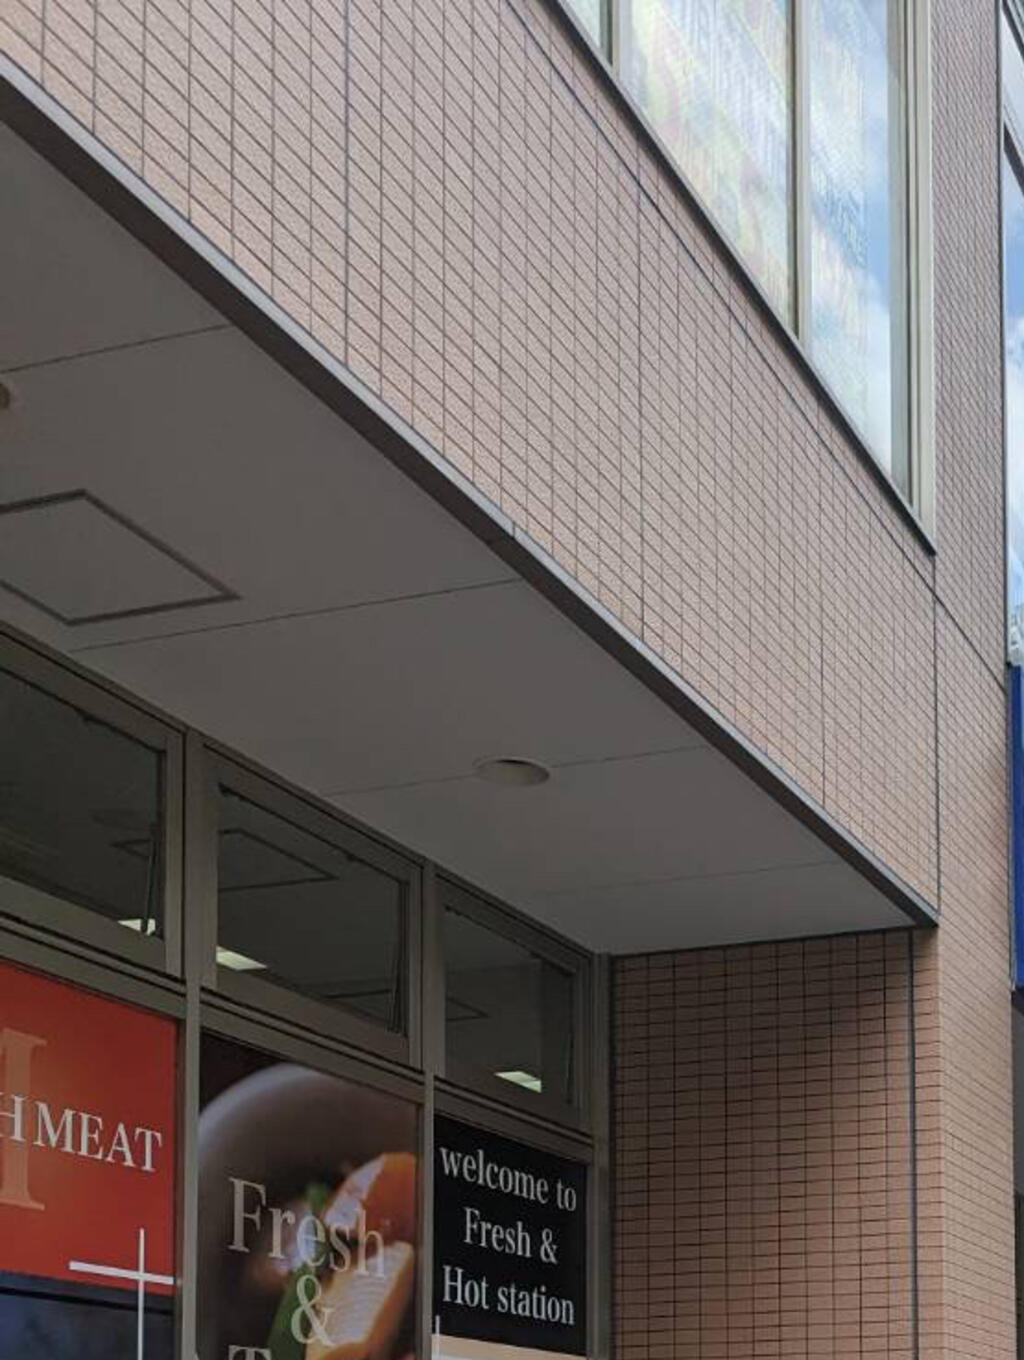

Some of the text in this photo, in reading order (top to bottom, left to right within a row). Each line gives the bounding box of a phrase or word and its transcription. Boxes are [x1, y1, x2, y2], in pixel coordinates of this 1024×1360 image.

[33, 1101, 163, 1173] MEAT
[440, 1147, 577, 1211] welcome to
[228, 1177, 387, 1280] Fresh
[464, 1206, 558, 1265] Fresh &
[291, 1274, 335, 1348] &
[442, 1264, 575, 1326] Hot station
